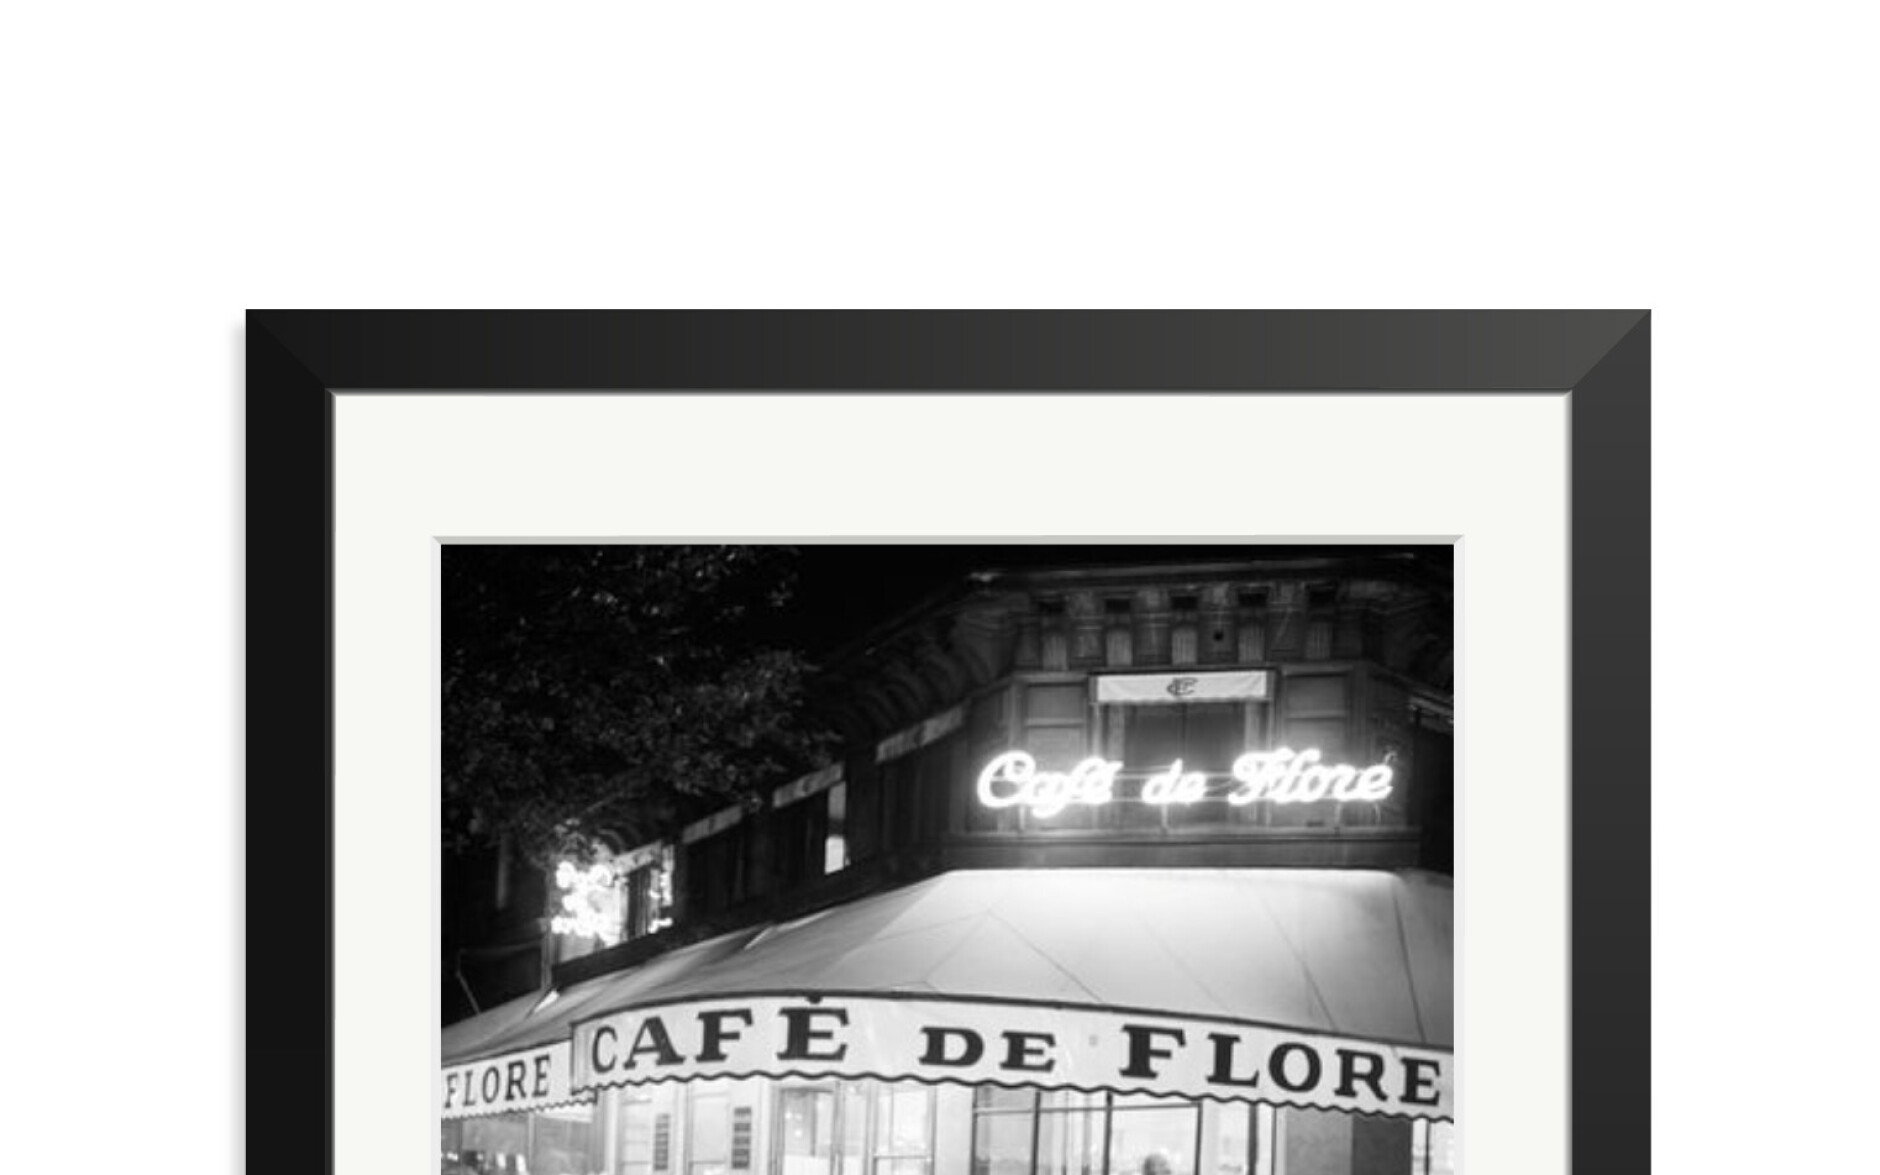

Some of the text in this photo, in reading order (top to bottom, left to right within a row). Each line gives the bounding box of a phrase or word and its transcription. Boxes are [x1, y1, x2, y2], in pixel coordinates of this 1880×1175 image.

[1142, 757, 1206, 807] de
[1227, 745, 1394, 806] Flore
[443, 1053, 551, 1110] FLORE
[919, 1025, 1057, 1072] DE
[1120, 1024, 1442, 1107] FLORE
